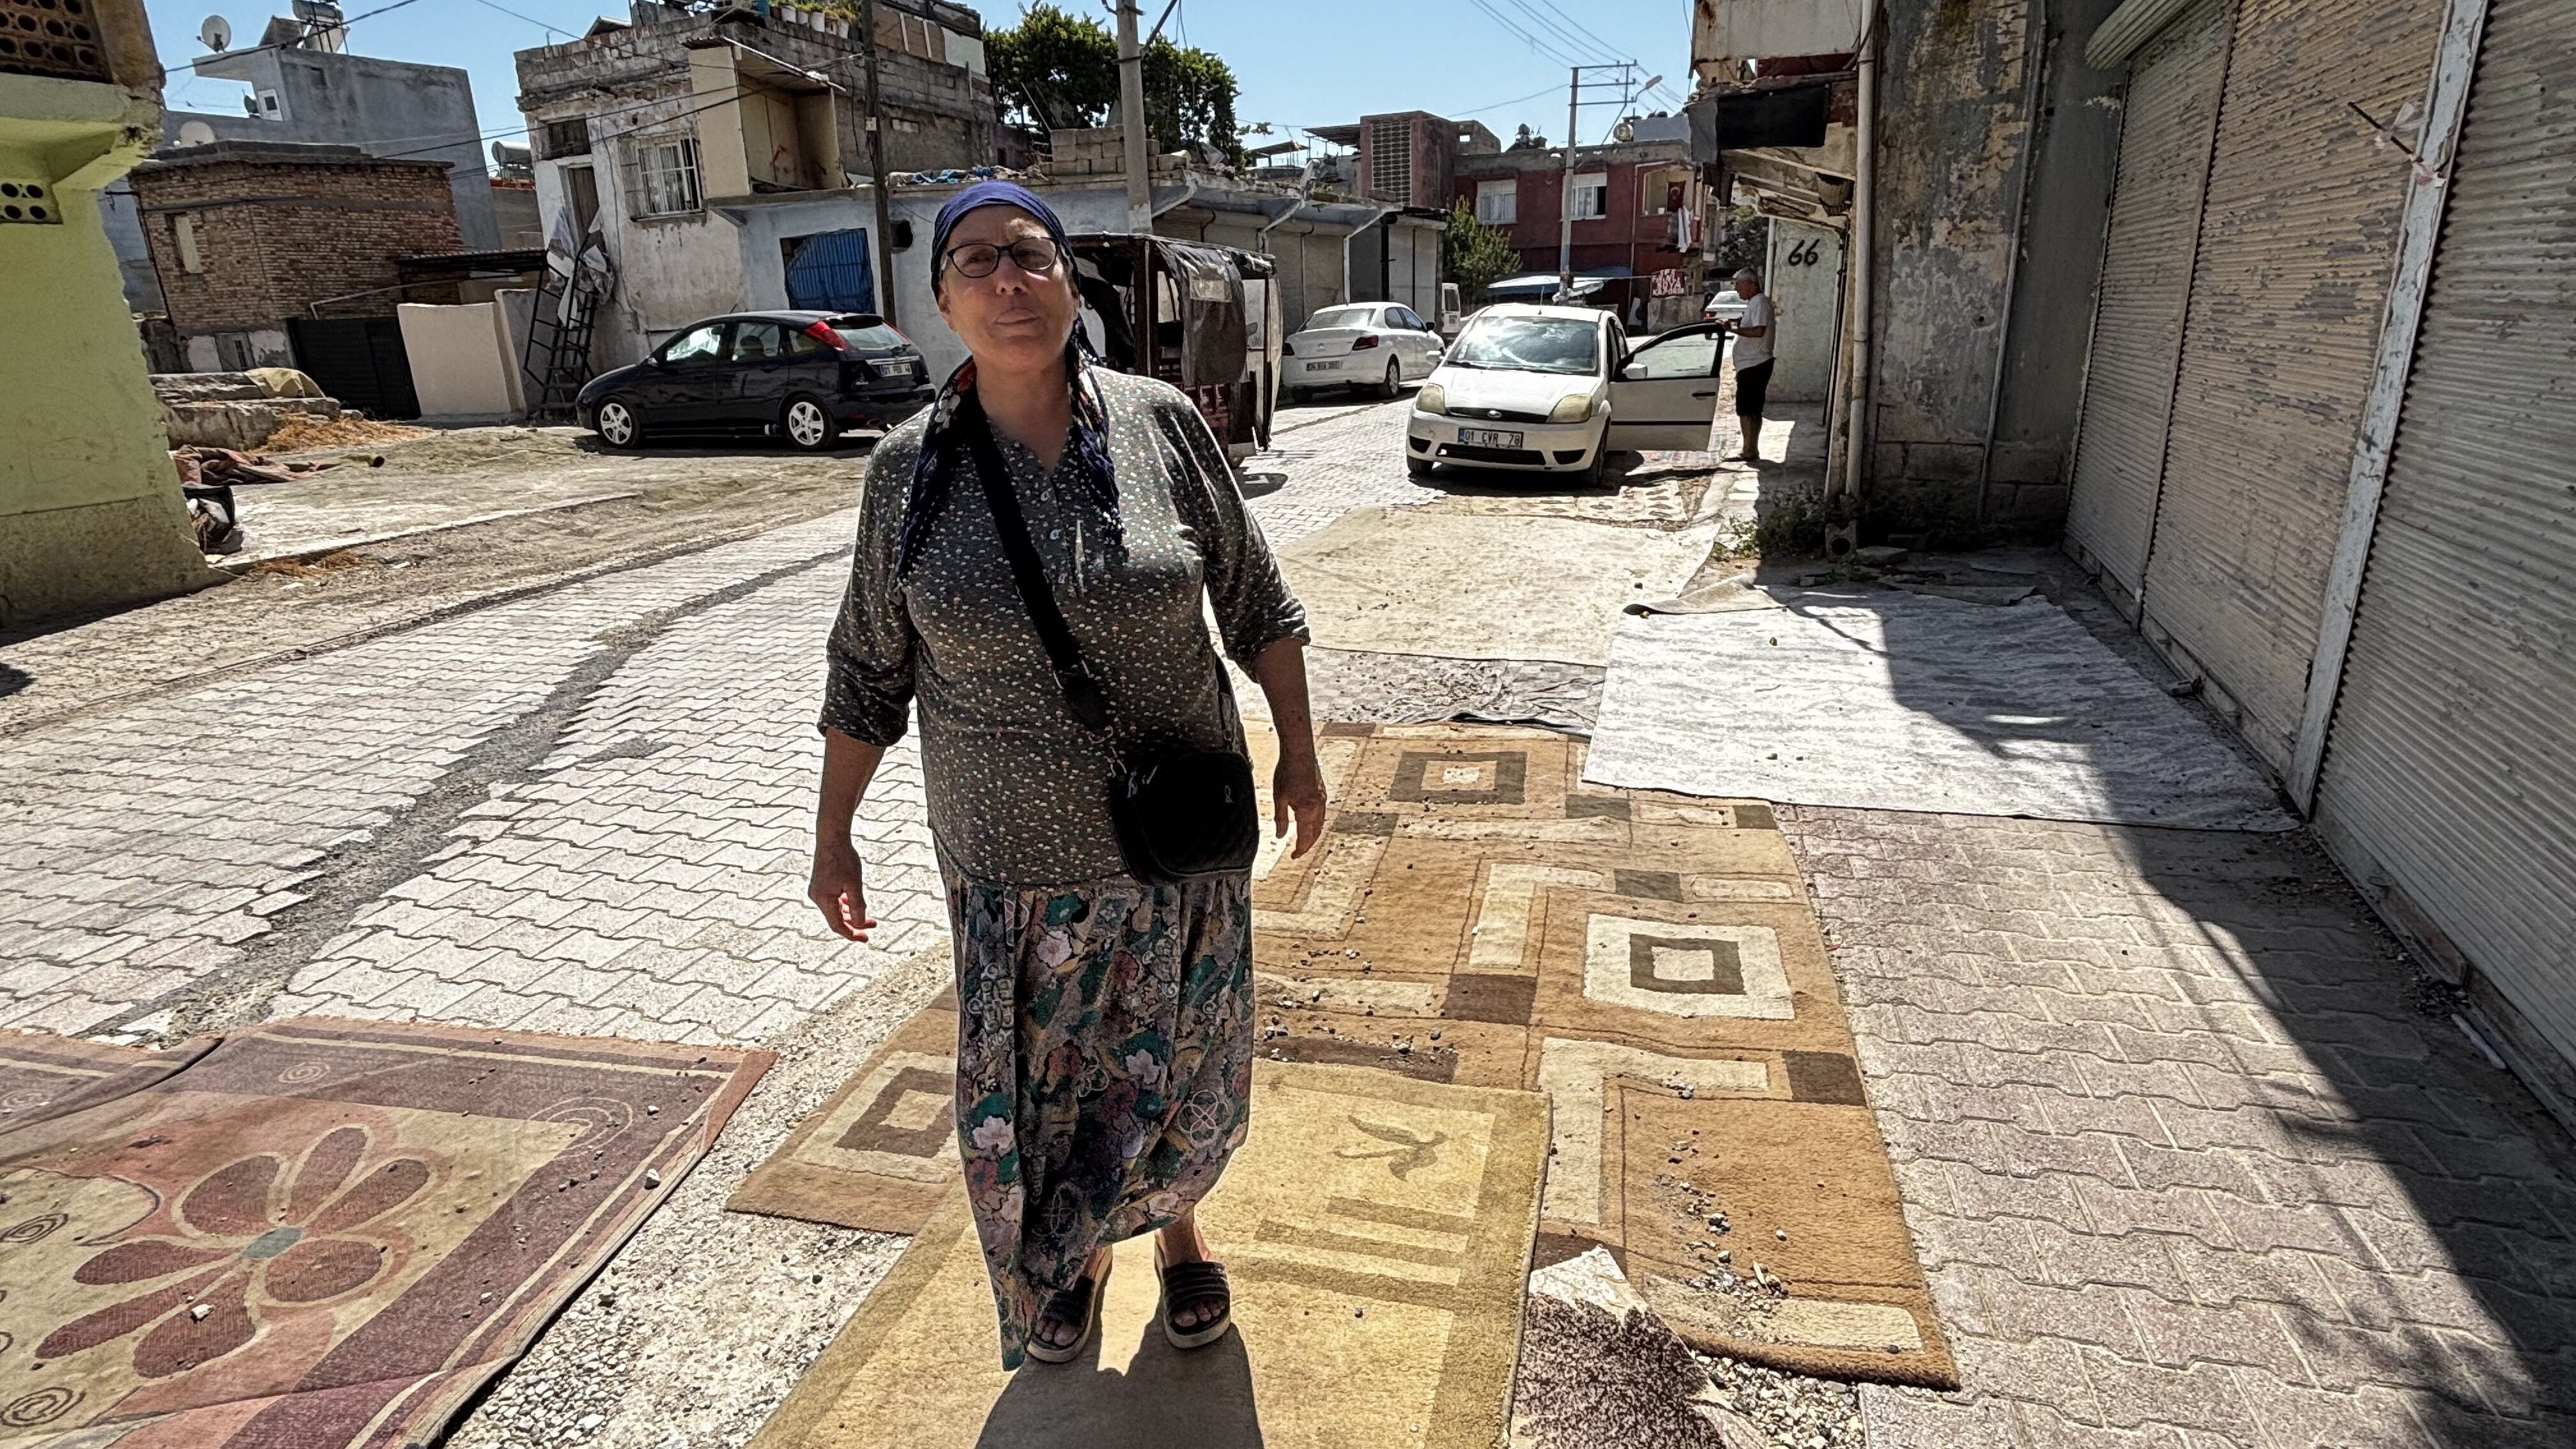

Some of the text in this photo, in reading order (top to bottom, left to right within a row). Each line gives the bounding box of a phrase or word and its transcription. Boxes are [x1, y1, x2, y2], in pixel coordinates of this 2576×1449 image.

[1788, 239, 1820, 266] 66
[1465, 431, 1520, 445] 01 CVR 78
